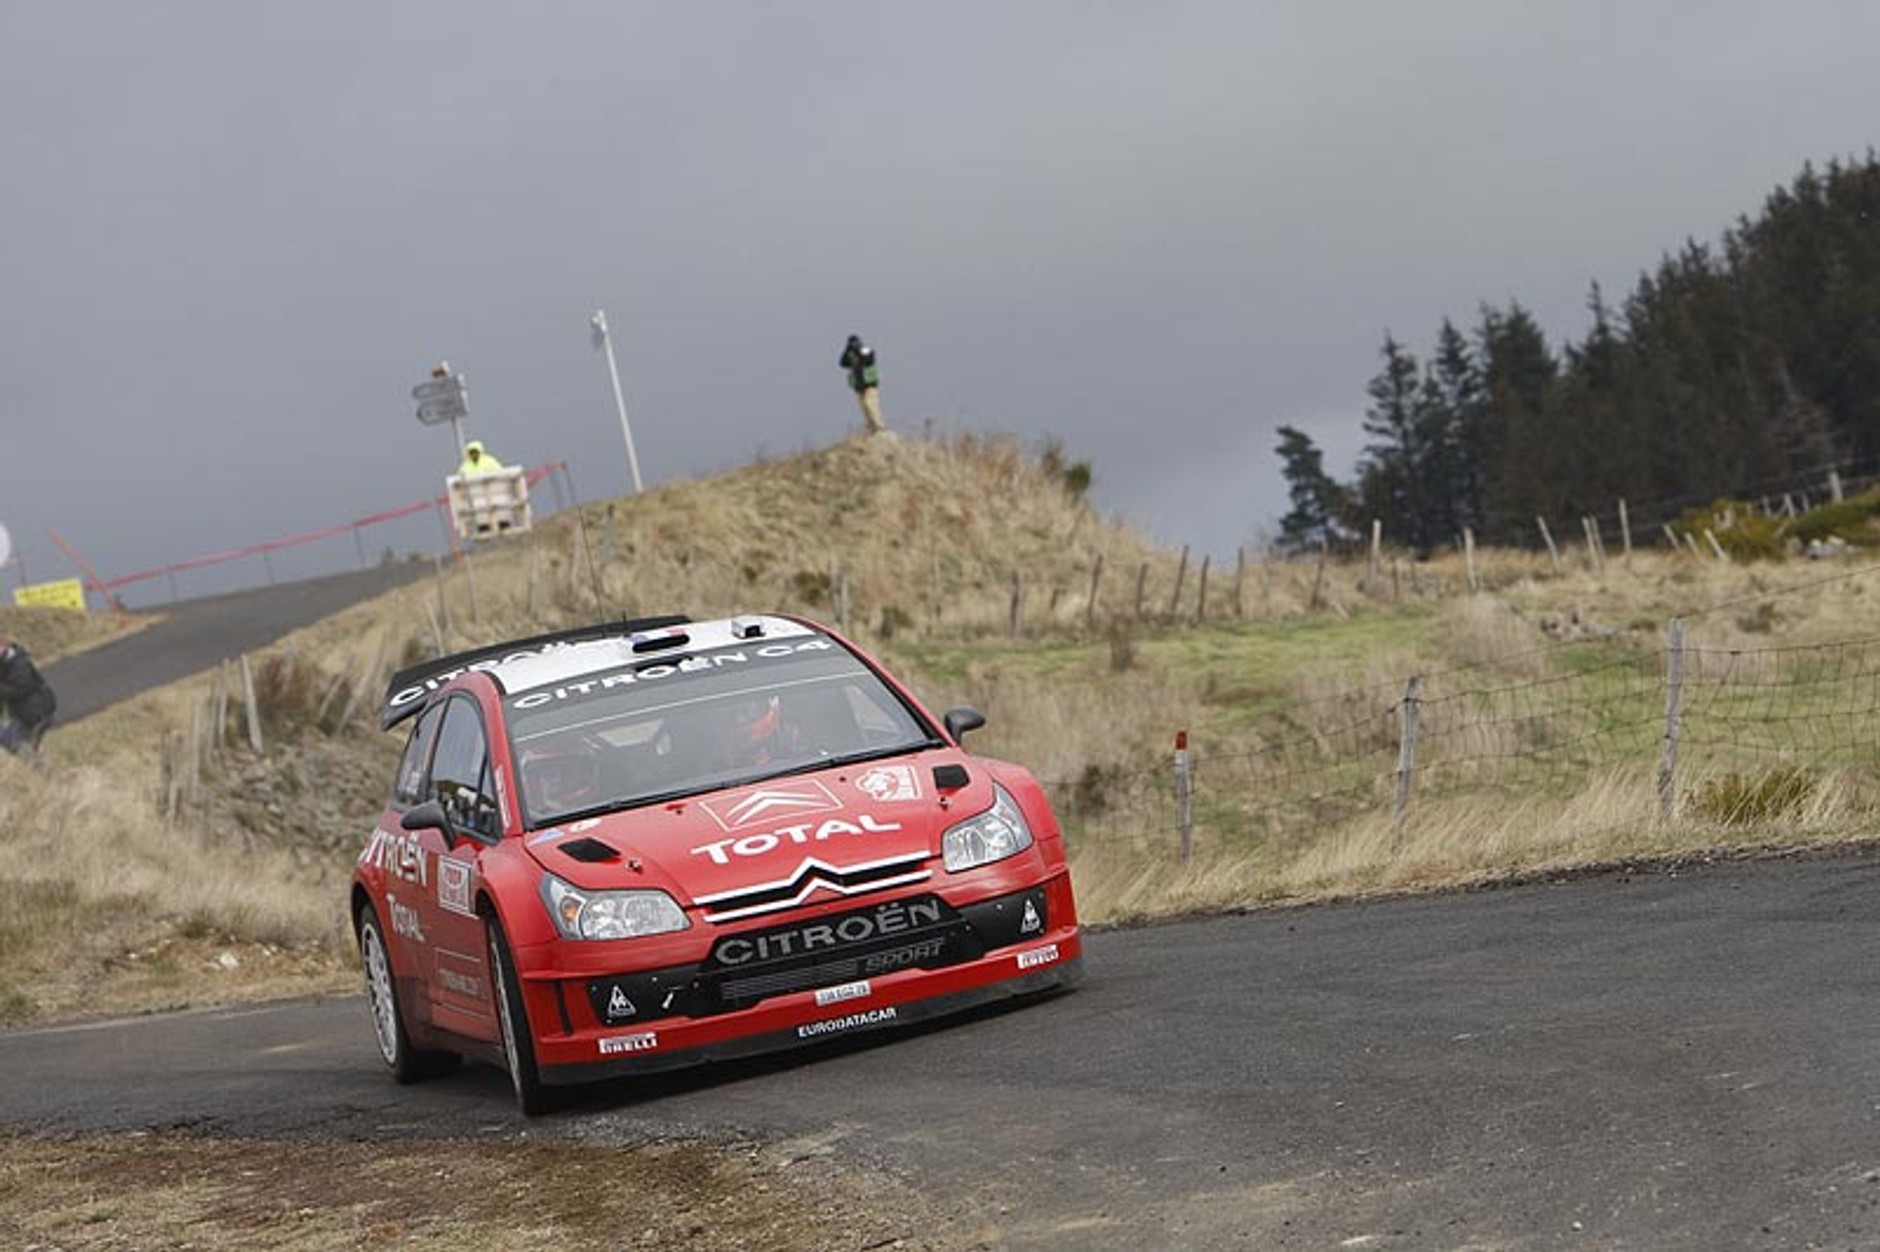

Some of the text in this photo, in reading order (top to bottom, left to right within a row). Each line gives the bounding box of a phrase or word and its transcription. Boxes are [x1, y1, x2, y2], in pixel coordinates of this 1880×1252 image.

[513, 651, 748, 708] CITROËN
[690, 814, 902, 865] TOTAL
[715, 899, 942, 965] CITROËN
[866, 937, 945, 971] SPORT
[598, 1031, 658, 1055] PIRELLI
[798, 1007, 897, 1037] EURODATACAR
